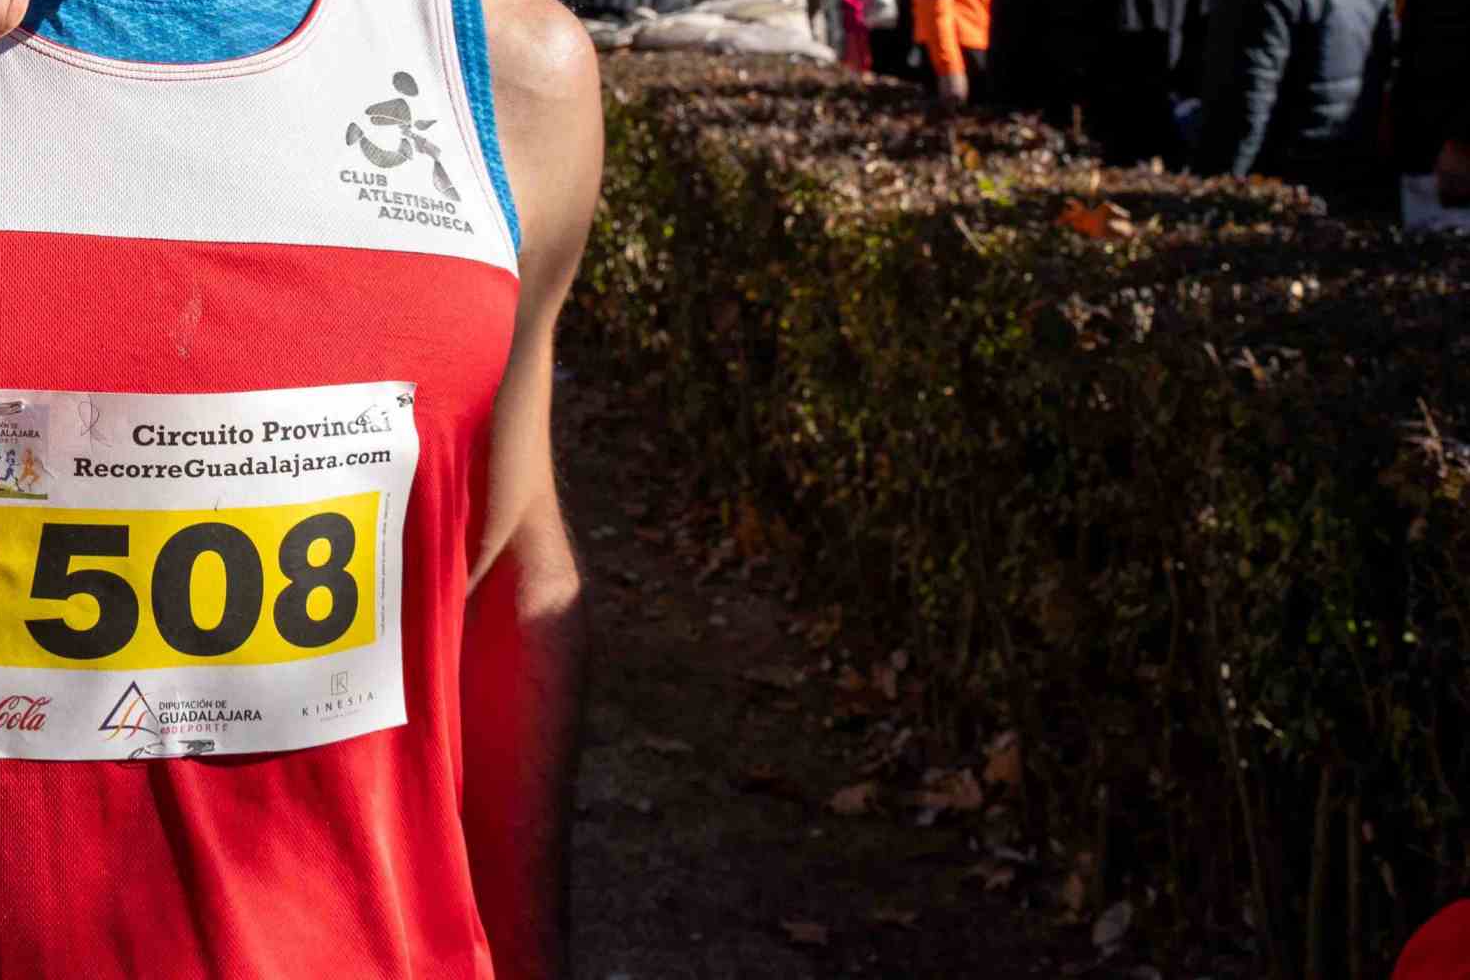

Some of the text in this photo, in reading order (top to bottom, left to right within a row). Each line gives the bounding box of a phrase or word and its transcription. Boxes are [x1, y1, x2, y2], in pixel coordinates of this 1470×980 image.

[340, 170, 388, 187] CLUB
[358, 187, 456, 216] ATLETISMO
[378, 206, 475, 235] AZUQUECA
[132, 423, 254, 447] Circuito
[73, 450, 392, 480] RecorreGuadalajara.com
[24, 512, 359, 661] 508
[159, 698, 227, 710] DIPUTACIÓN DE
[159, 709, 263, 724] GUADALAJARA
[302, 691, 370, 717] KINESIA
